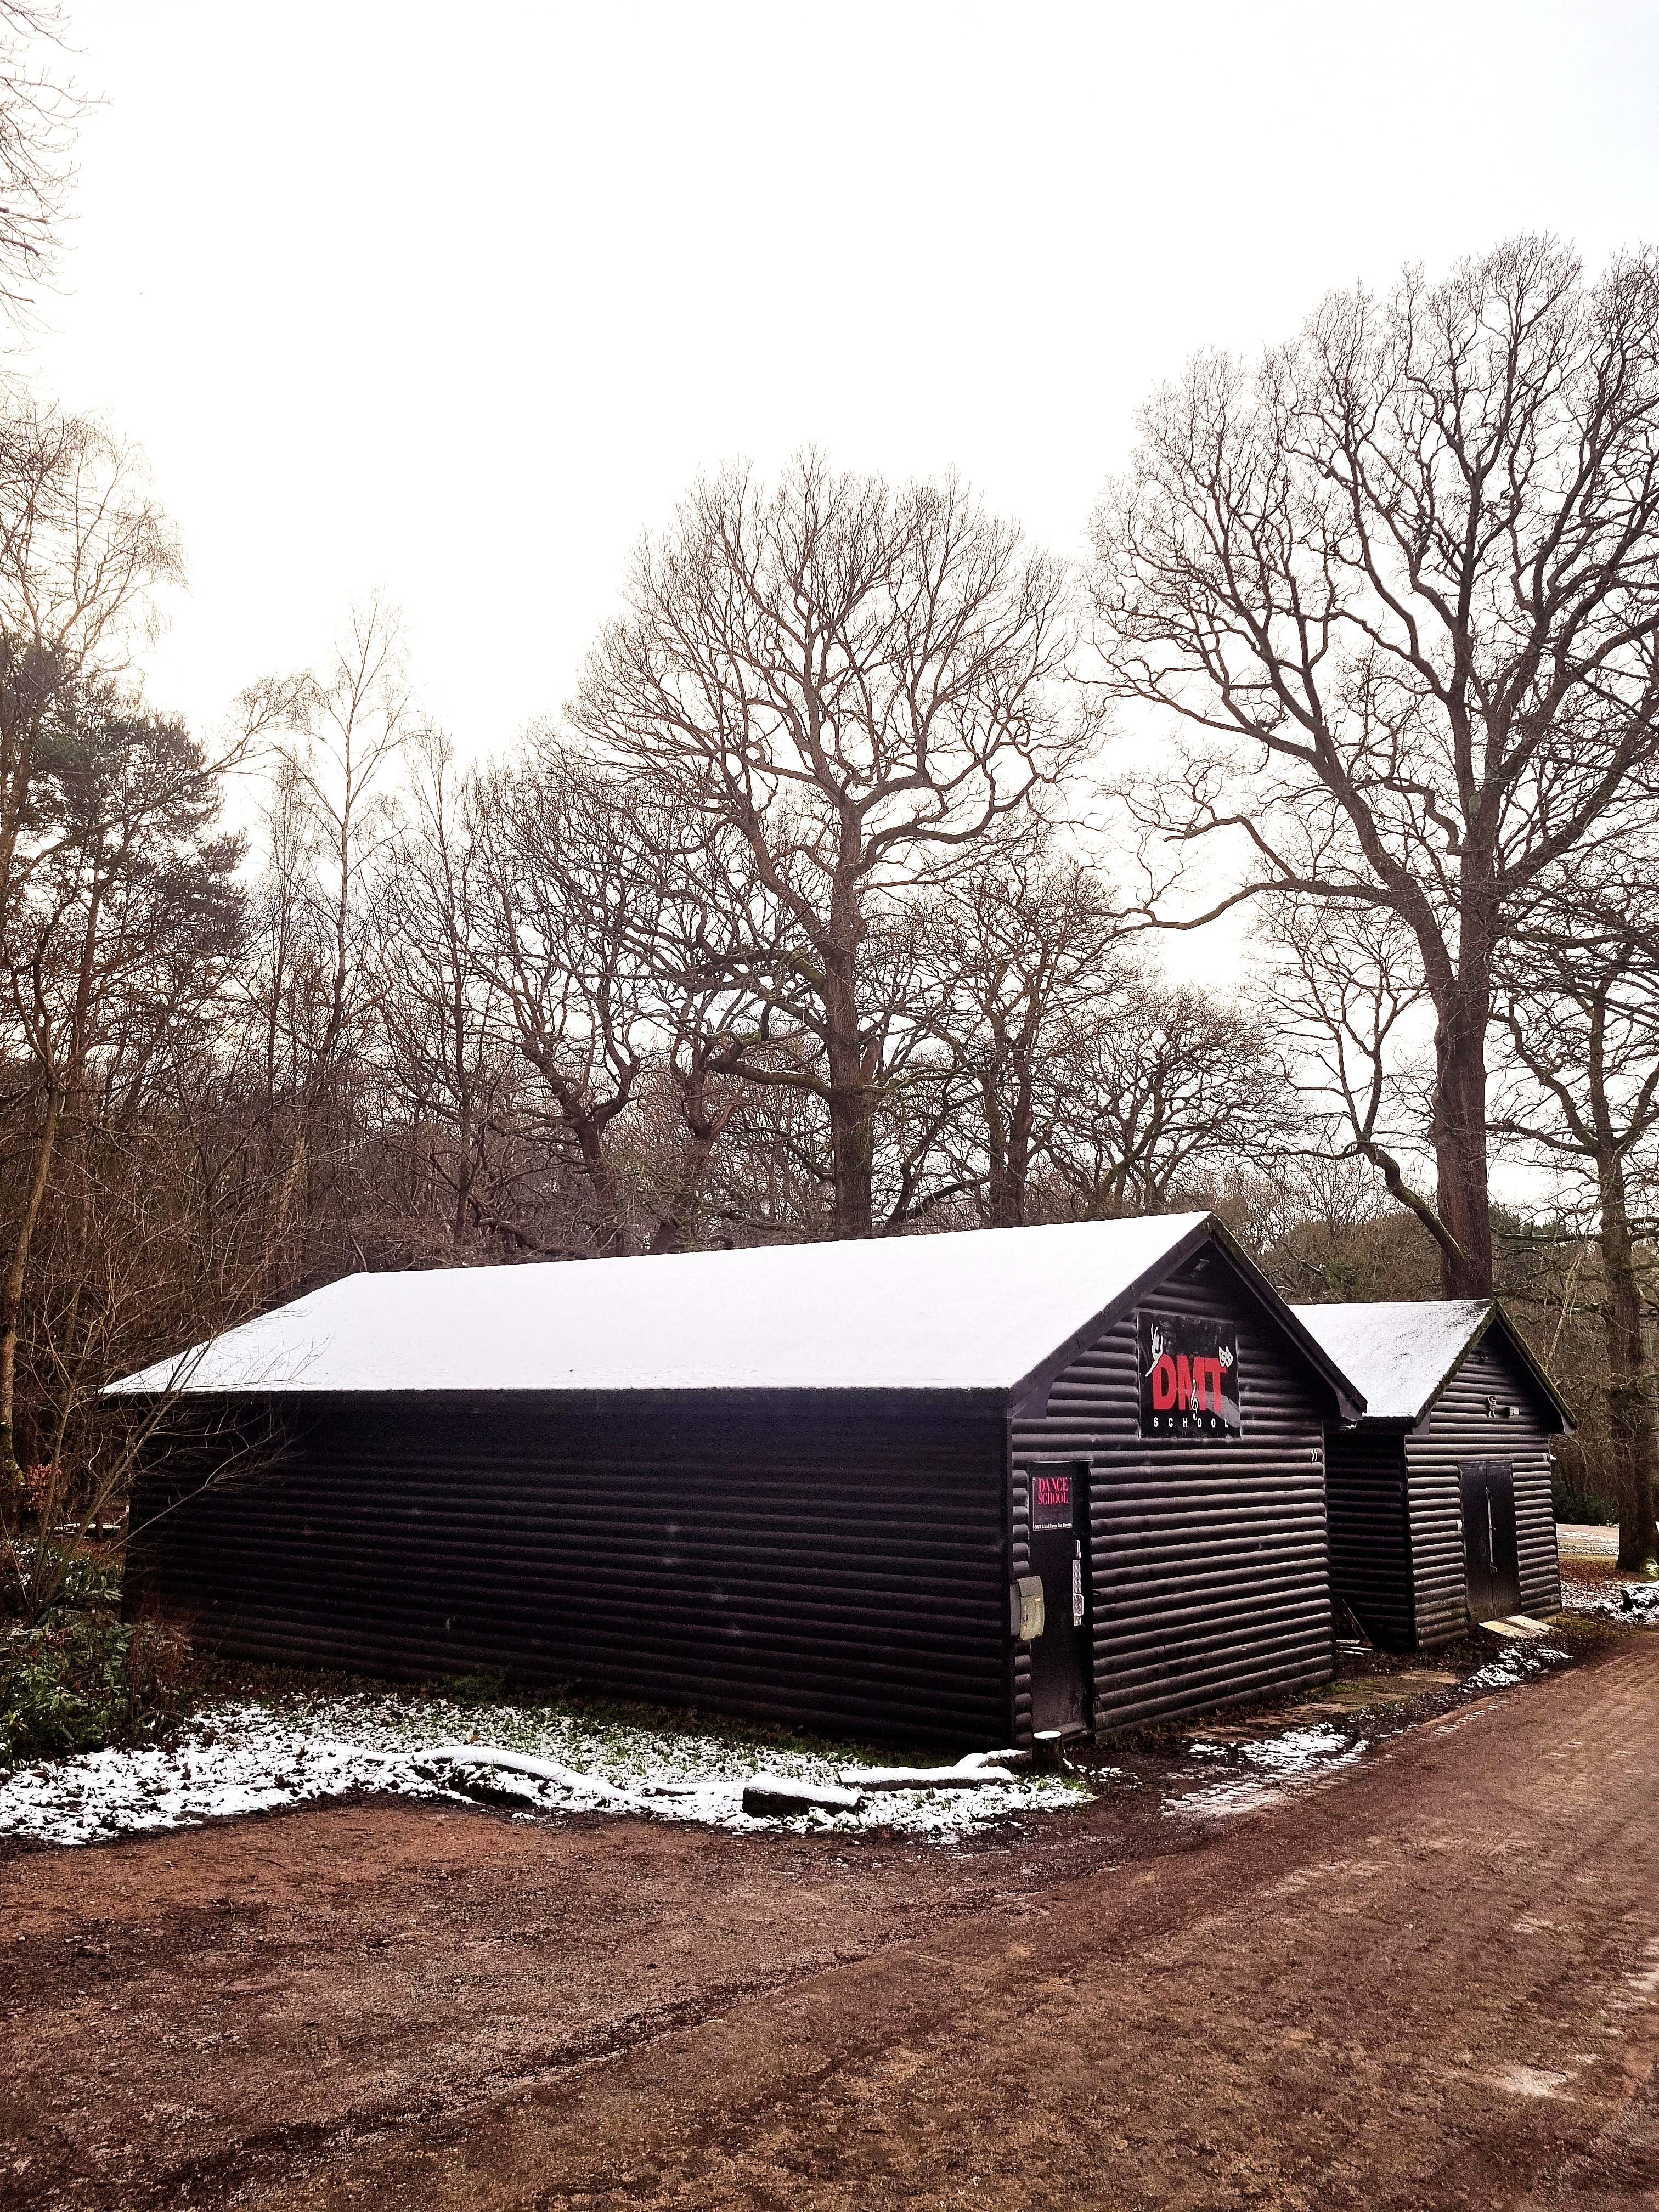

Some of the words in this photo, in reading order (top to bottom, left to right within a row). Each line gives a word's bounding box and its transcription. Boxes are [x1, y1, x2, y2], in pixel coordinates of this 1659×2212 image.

[1152, 1353, 1227, 1412] DMT
[1153, 1417, 1229, 1428] SCHOOL
[1039, 1477, 1068, 1492] DANCE
[1037, 1492, 1068, 1504] SCHOOL
